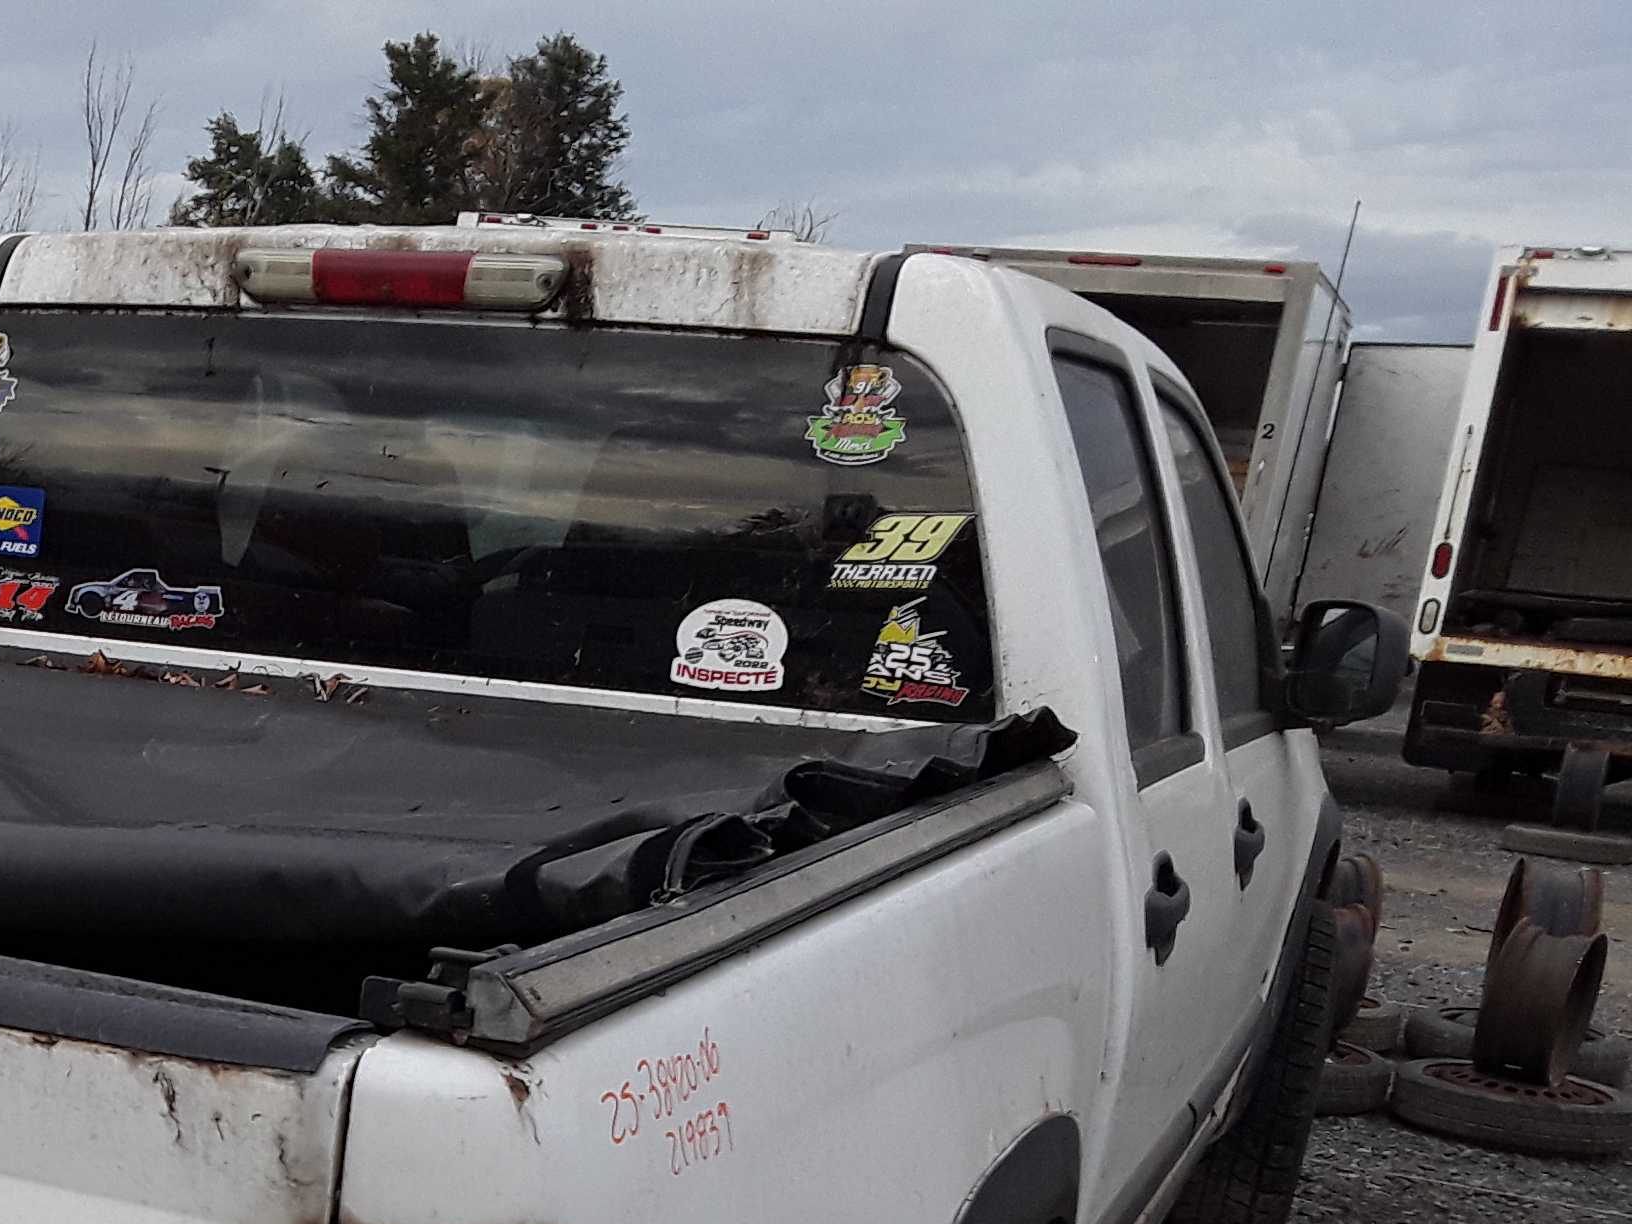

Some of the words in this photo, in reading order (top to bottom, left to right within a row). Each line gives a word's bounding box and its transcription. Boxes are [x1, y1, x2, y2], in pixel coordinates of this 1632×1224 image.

[841, 411, 878, 425] ROY
[1261, 423, 1275, 439] 2
[0, 540, 38, 555] FUELS
[841, 514, 970, 563] 39
[830, 563, 938, 581] THERRIEN
[112, 589, 139, 612] 4
[99, 610, 170, 628] LETOURNEAU
[709, 615, 771, 632] Speedway
[733, 660, 769, 670] 2022
[884, 643, 934, 673] 25
[675, 663, 779, 686] INSPECTÉ
[866, 662, 952, 685] ANS
